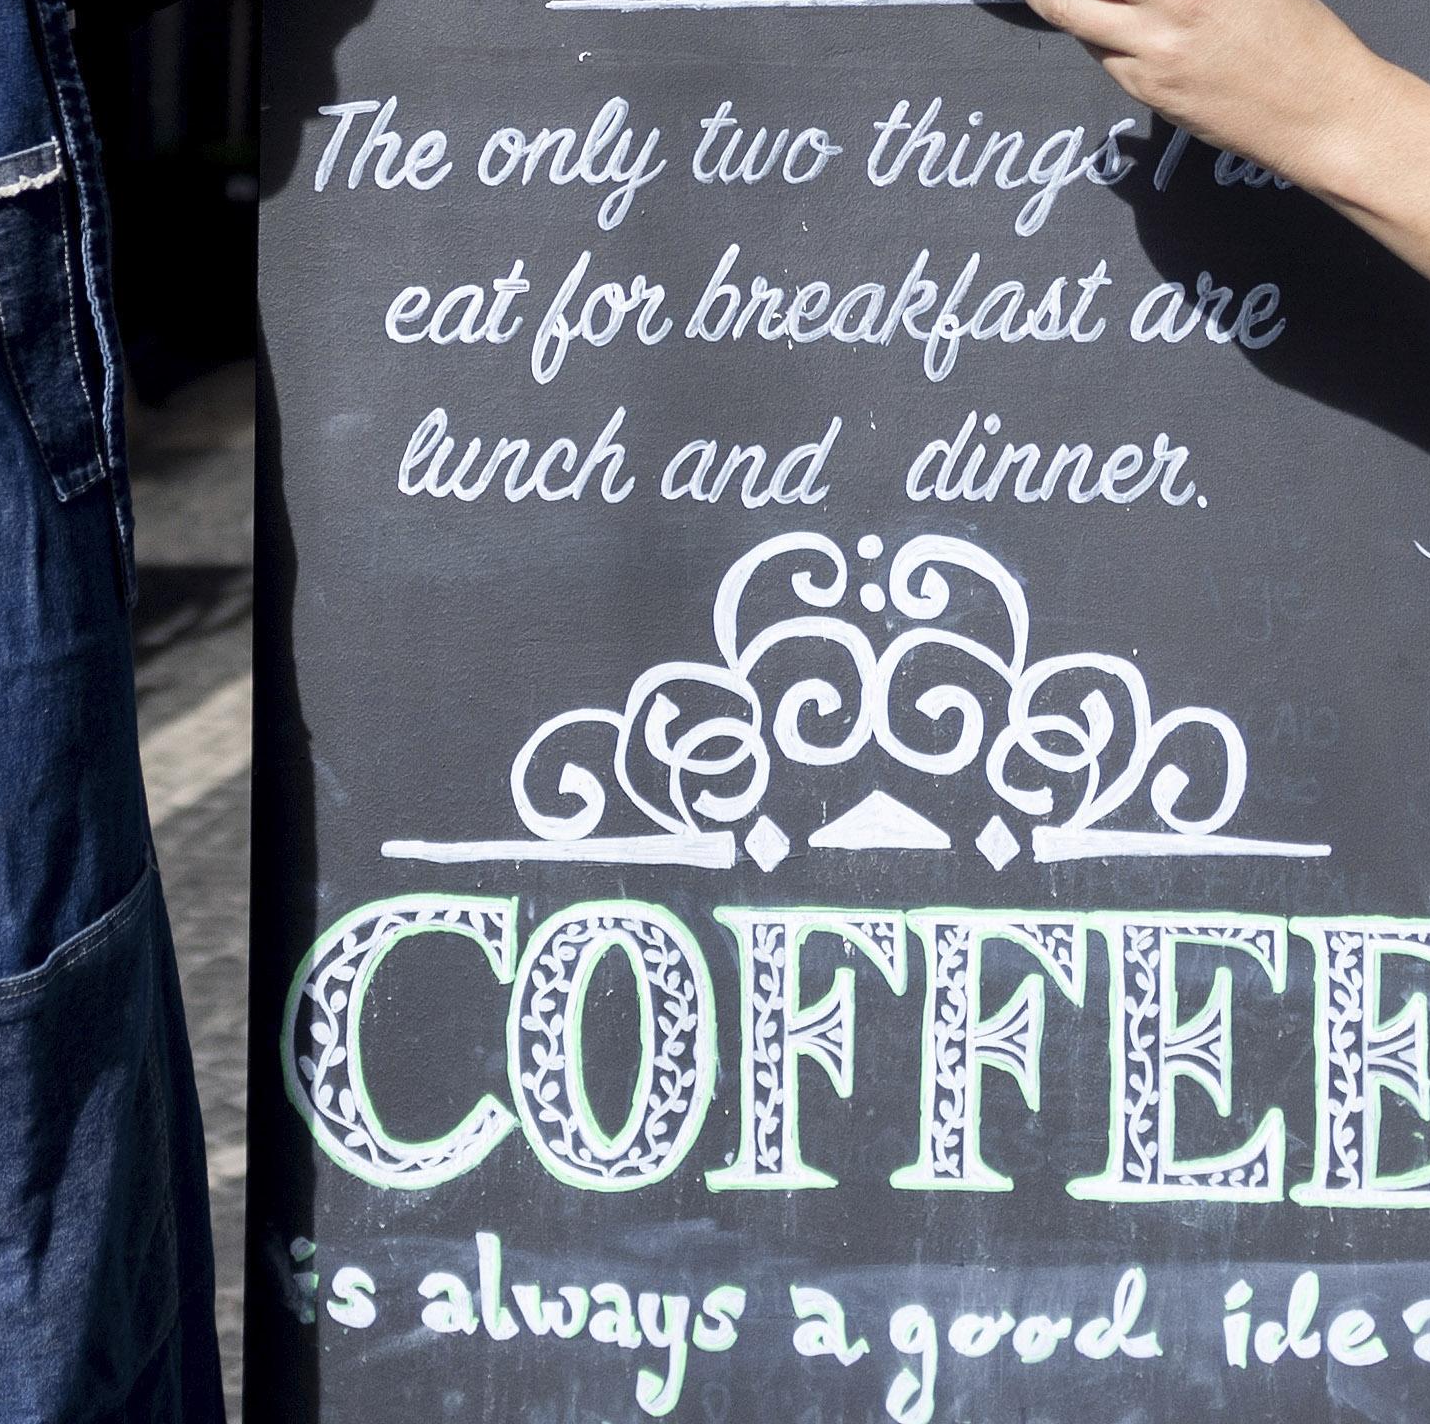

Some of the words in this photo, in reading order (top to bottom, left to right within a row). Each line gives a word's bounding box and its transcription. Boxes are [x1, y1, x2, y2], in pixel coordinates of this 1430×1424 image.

[315, 95, 452, 192] The
[478, 96, 667, 230] only
[693, 101, 843, 185] two
[867, 97, 1137, 237] things
[385, 259, 530, 345] eat
[531, 250, 673, 385] for
[685, 243, 1112, 382] breakfast
[1129, 272, 1286, 352] are
[398, 407, 635, 504] lunch
[660, 416, 843, 510] and
[906, 411, 1208, 510] dinner.
[289, 1236, 377, 1330] is
[420, 1233, 748, 1418] always
[791, 1283, 870, 1366] a
[886, 1266, 1163, 1424] good
